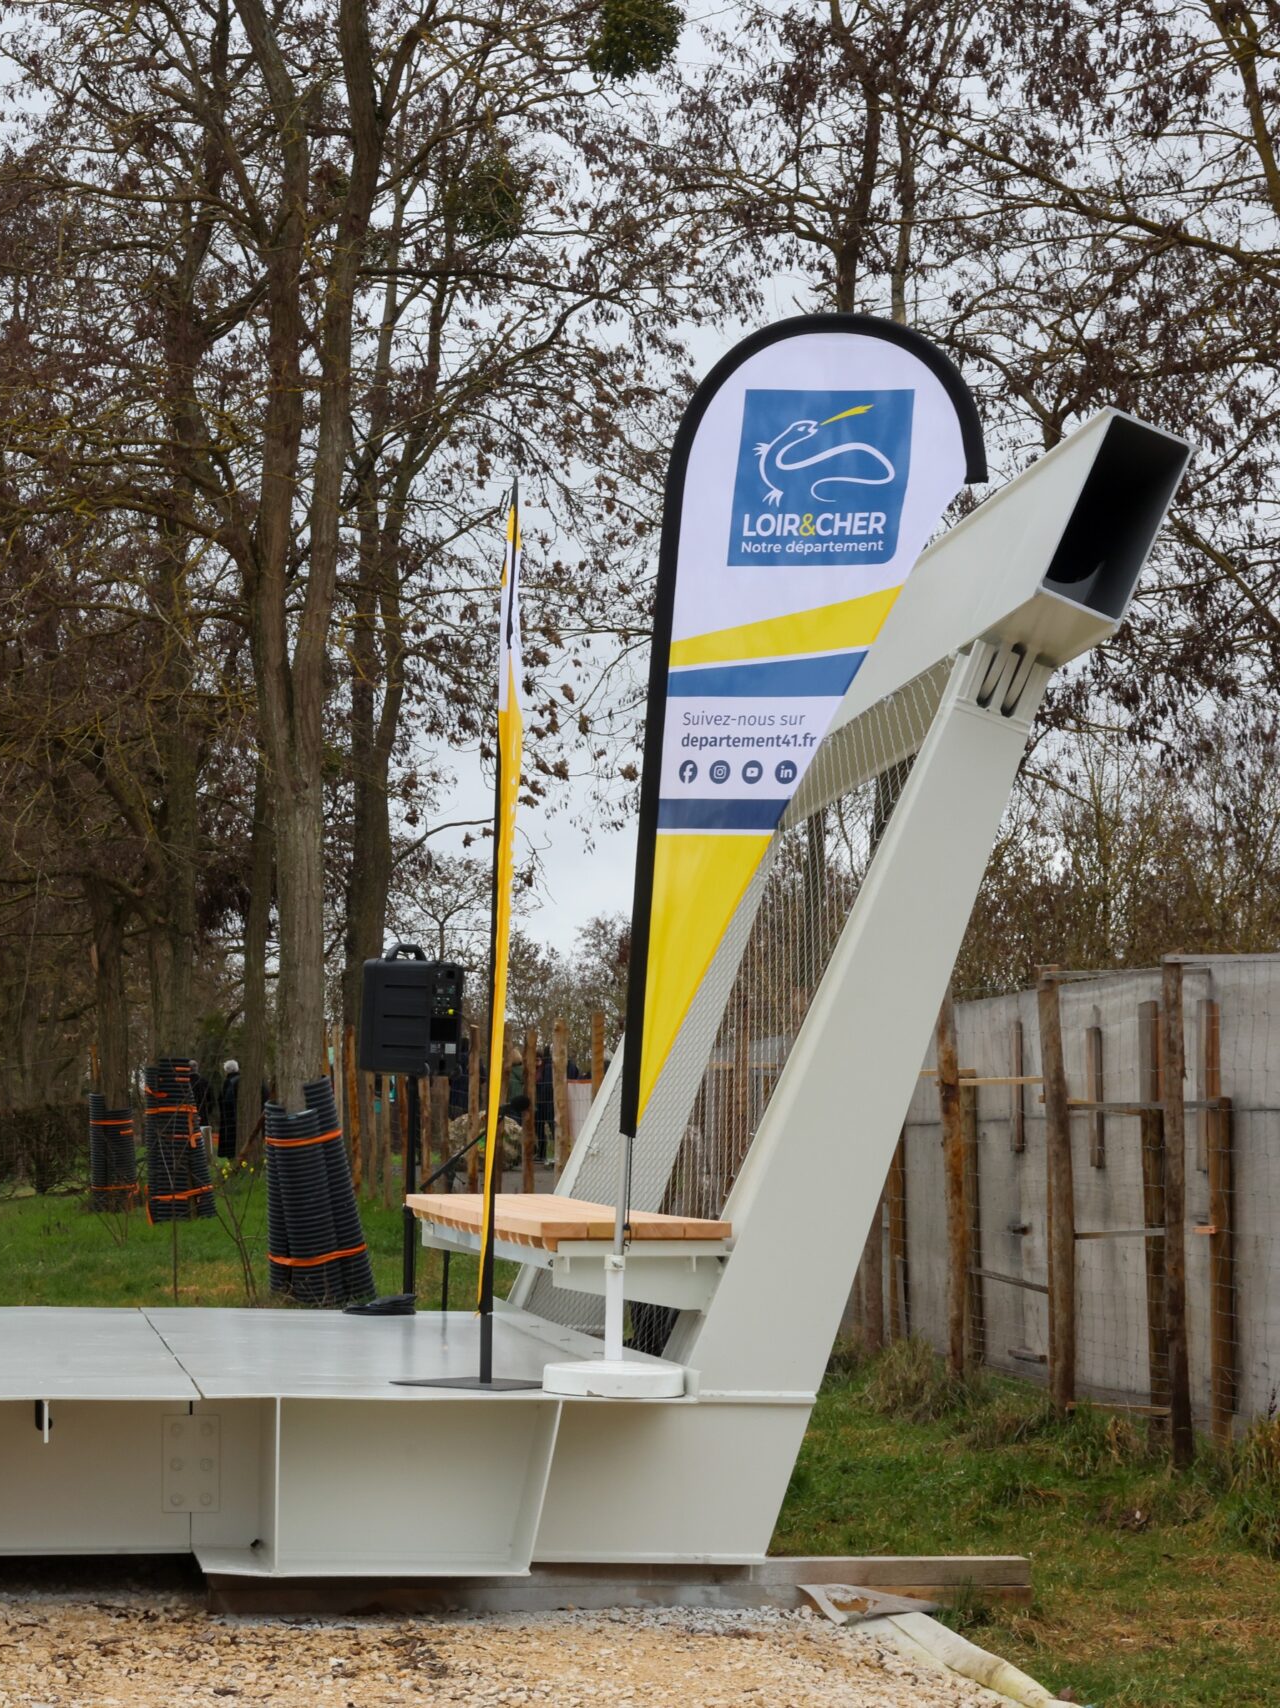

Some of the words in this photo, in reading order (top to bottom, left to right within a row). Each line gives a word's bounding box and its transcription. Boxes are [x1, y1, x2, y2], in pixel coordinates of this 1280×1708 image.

[742, 511, 887, 537] LOIR&CHER
[741, 541, 782, 553] Notre
[785, 539, 884, 556] département
[682, 710, 776, 726] Suivez-nous
[779, 714, 806, 726] sur
[681, 732, 817, 751] departement41.fr
